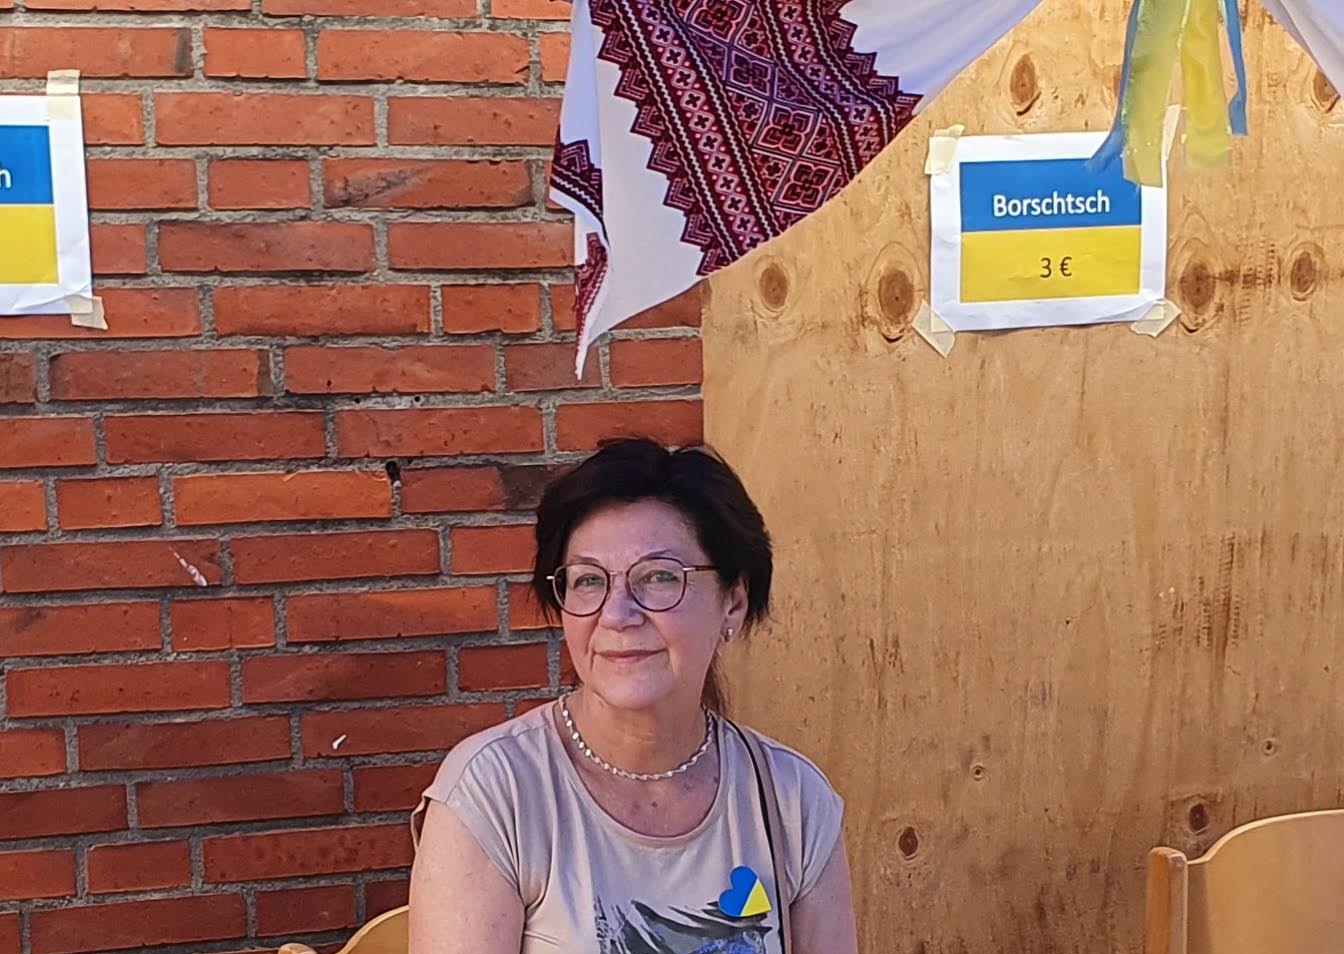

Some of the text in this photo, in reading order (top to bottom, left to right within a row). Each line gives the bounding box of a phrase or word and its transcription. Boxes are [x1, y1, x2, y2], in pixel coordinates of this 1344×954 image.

[992, 189, 1110, 217] Borschtsch
[1039, 256, 1073, 278] 3 €
